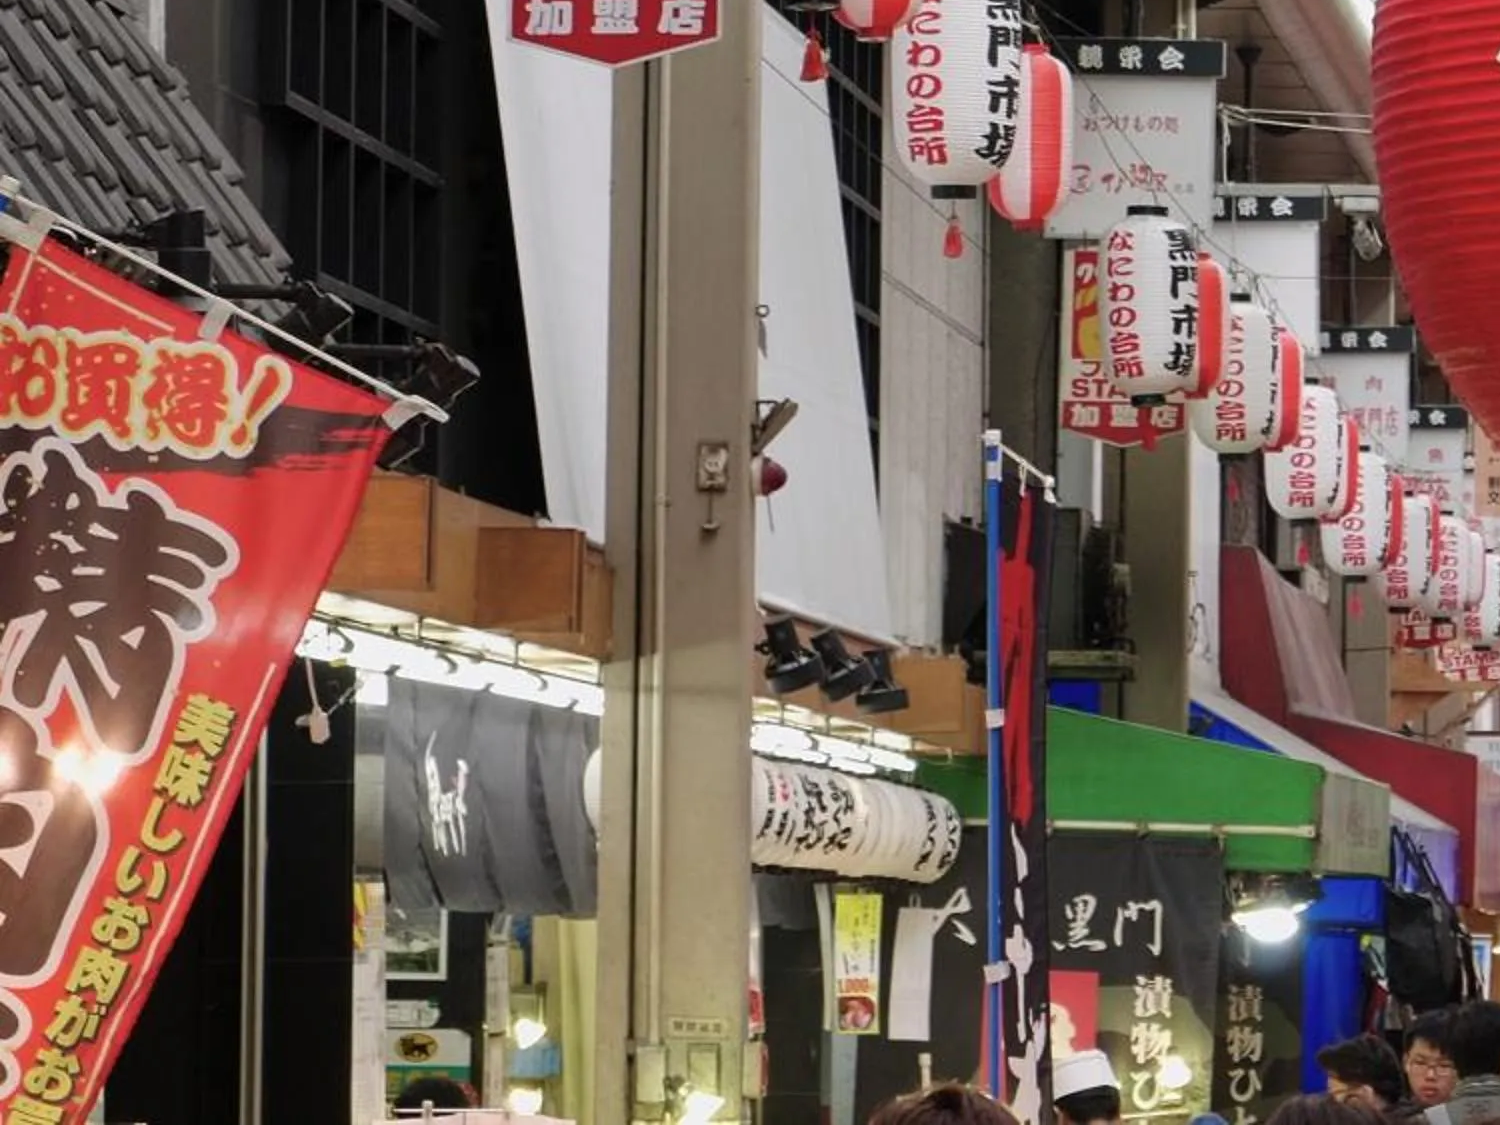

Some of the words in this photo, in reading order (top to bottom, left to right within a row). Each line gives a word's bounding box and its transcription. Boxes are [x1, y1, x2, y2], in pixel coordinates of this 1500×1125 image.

[1107, 230, 1144, 379] なにわの台所
[1163, 228, 1198, 376] 黒門市場
[1070, 405, 1178, 428] 加盟店
[1071, 378, 1128, 398] STA
[1052, 893, 1163, 957] 黒門
